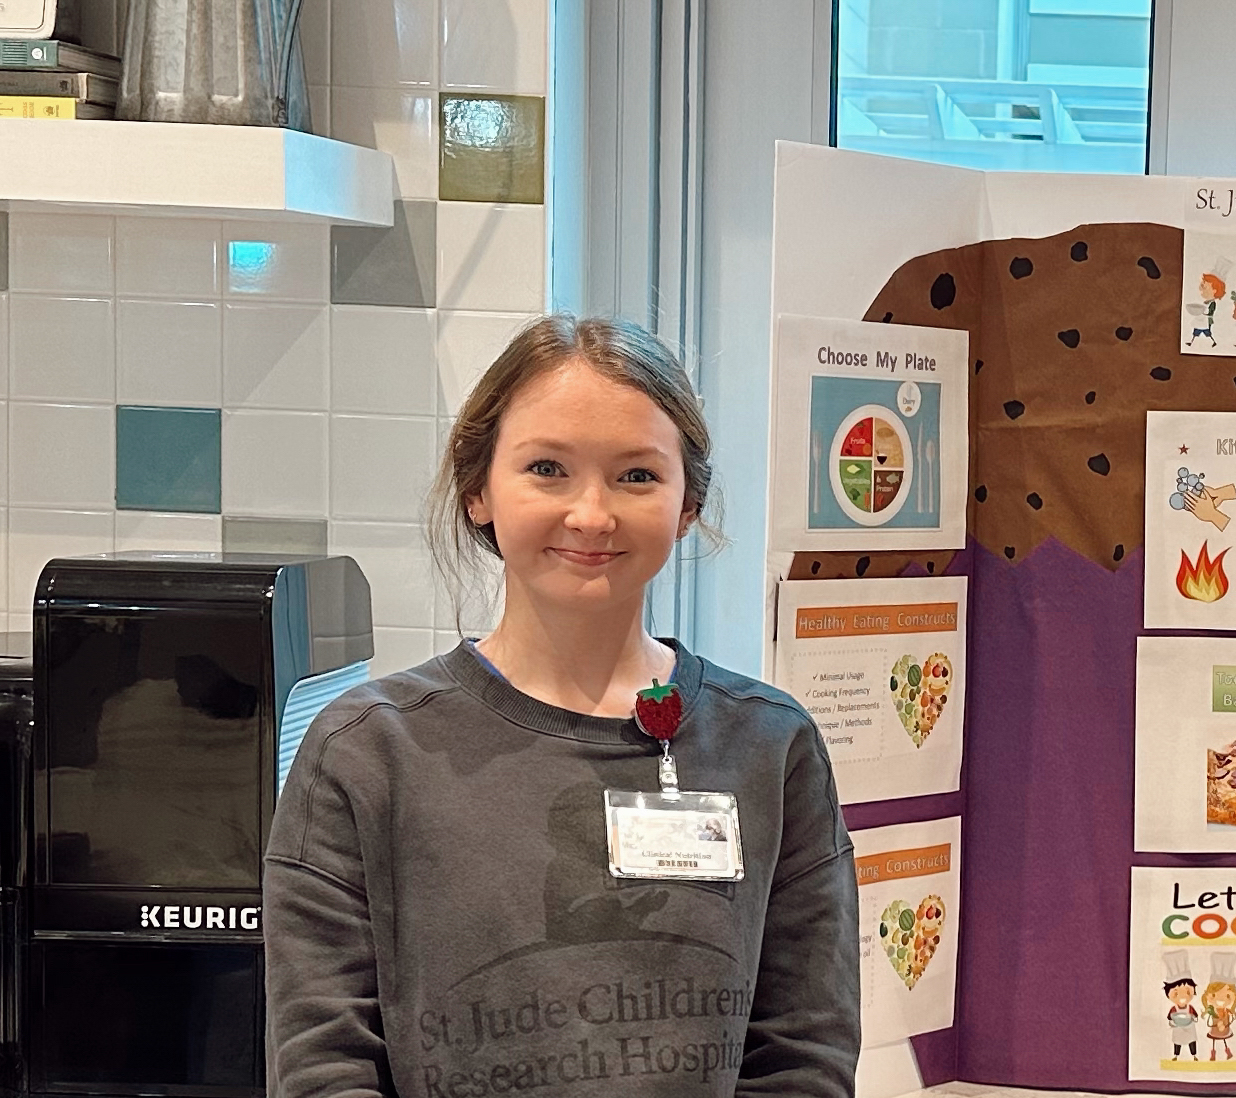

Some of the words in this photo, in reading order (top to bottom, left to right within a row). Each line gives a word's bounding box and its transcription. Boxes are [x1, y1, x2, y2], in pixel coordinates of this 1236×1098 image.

[1195, 187, 1221, 211] St.
[817, 346, 868, 367] Choose
[876, 351, 898, 373] My
[905, 353, 937, 372] Plate
[799, 615, 847, 633] Healthy
[853, 614, 890, 630] Eating
[897, 612, 956, 627] Constructs
[812, 688, 838, 699] Cooking
[838, 687, 871, 698] Frequency
[886, 853, 950, 874] Constructs
[140, 905, 259, 929] KEURIG
[466, 987, 568, 1055] Jude
[615, 1032, 743, 1084] Hospita
